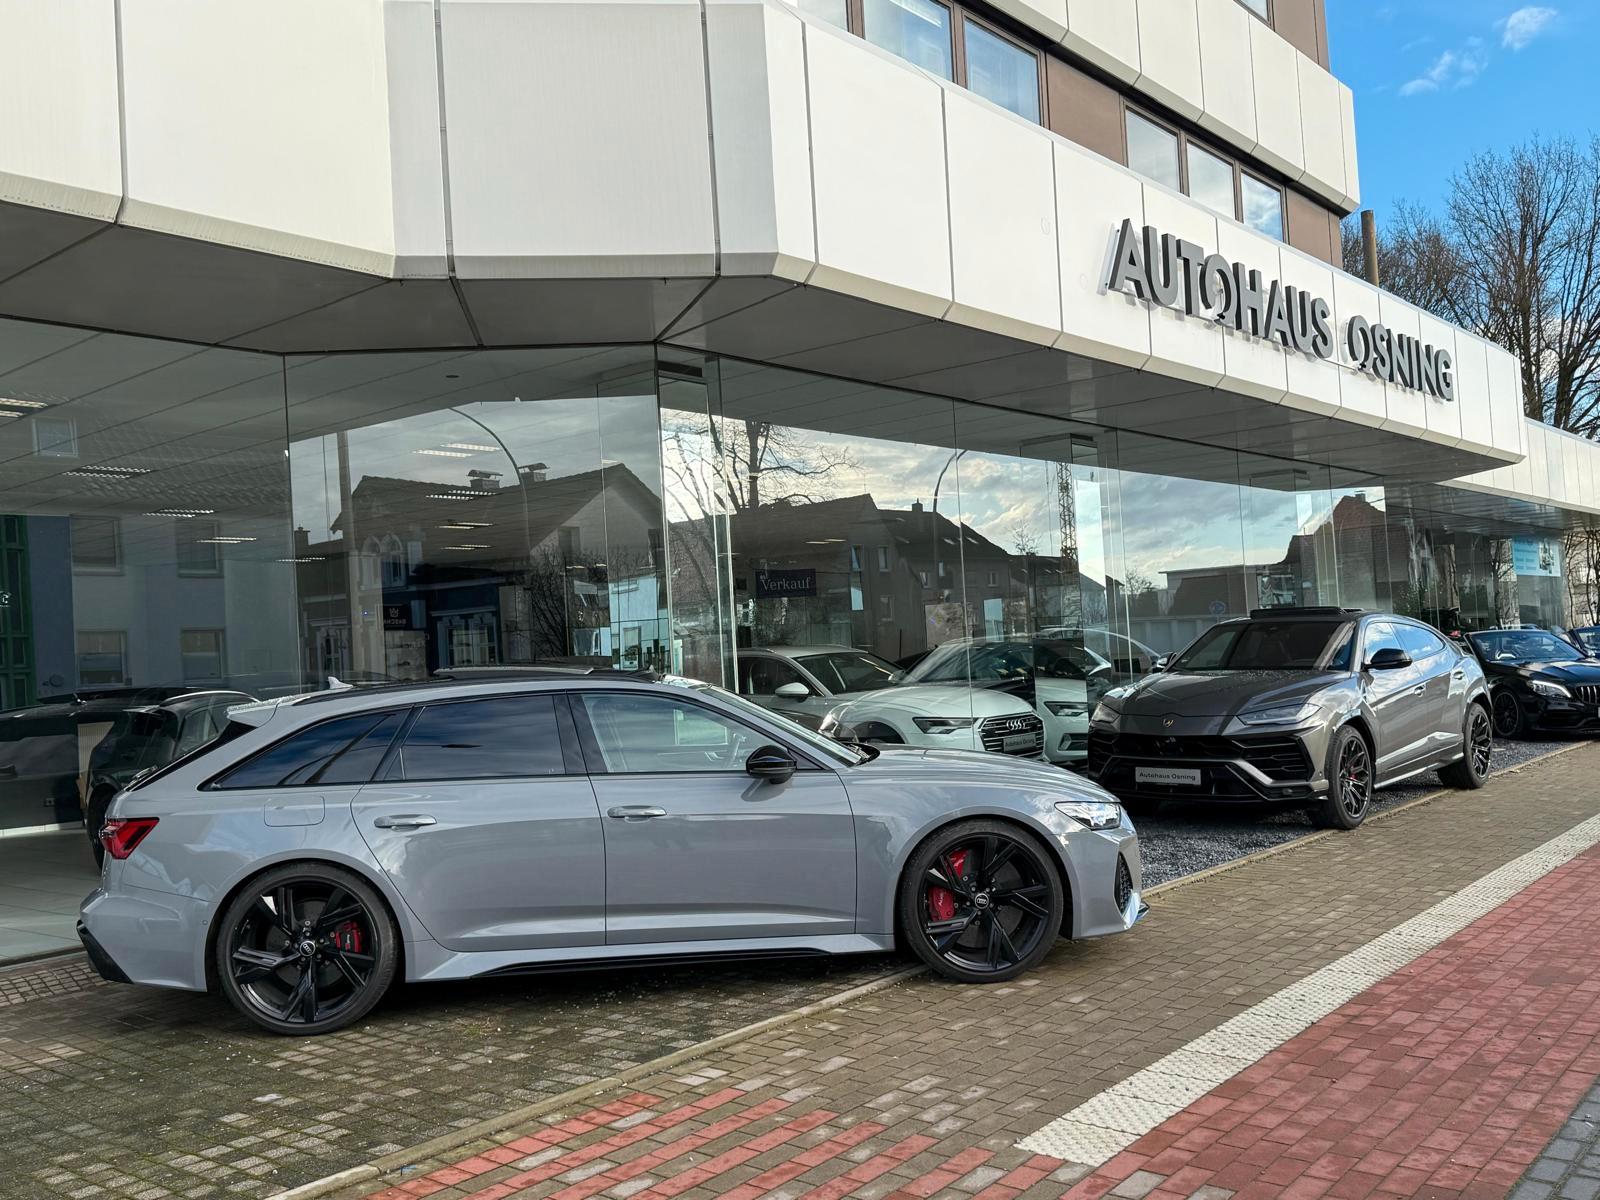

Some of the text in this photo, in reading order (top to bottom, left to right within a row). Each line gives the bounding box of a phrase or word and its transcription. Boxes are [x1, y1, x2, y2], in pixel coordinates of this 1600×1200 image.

[1108, 218, 1453, 401] AUTOHAUS OSNING
[760, 576, 811, 591] Verkauf
[1139, 771, 1196, 781] Autohaus Osning
